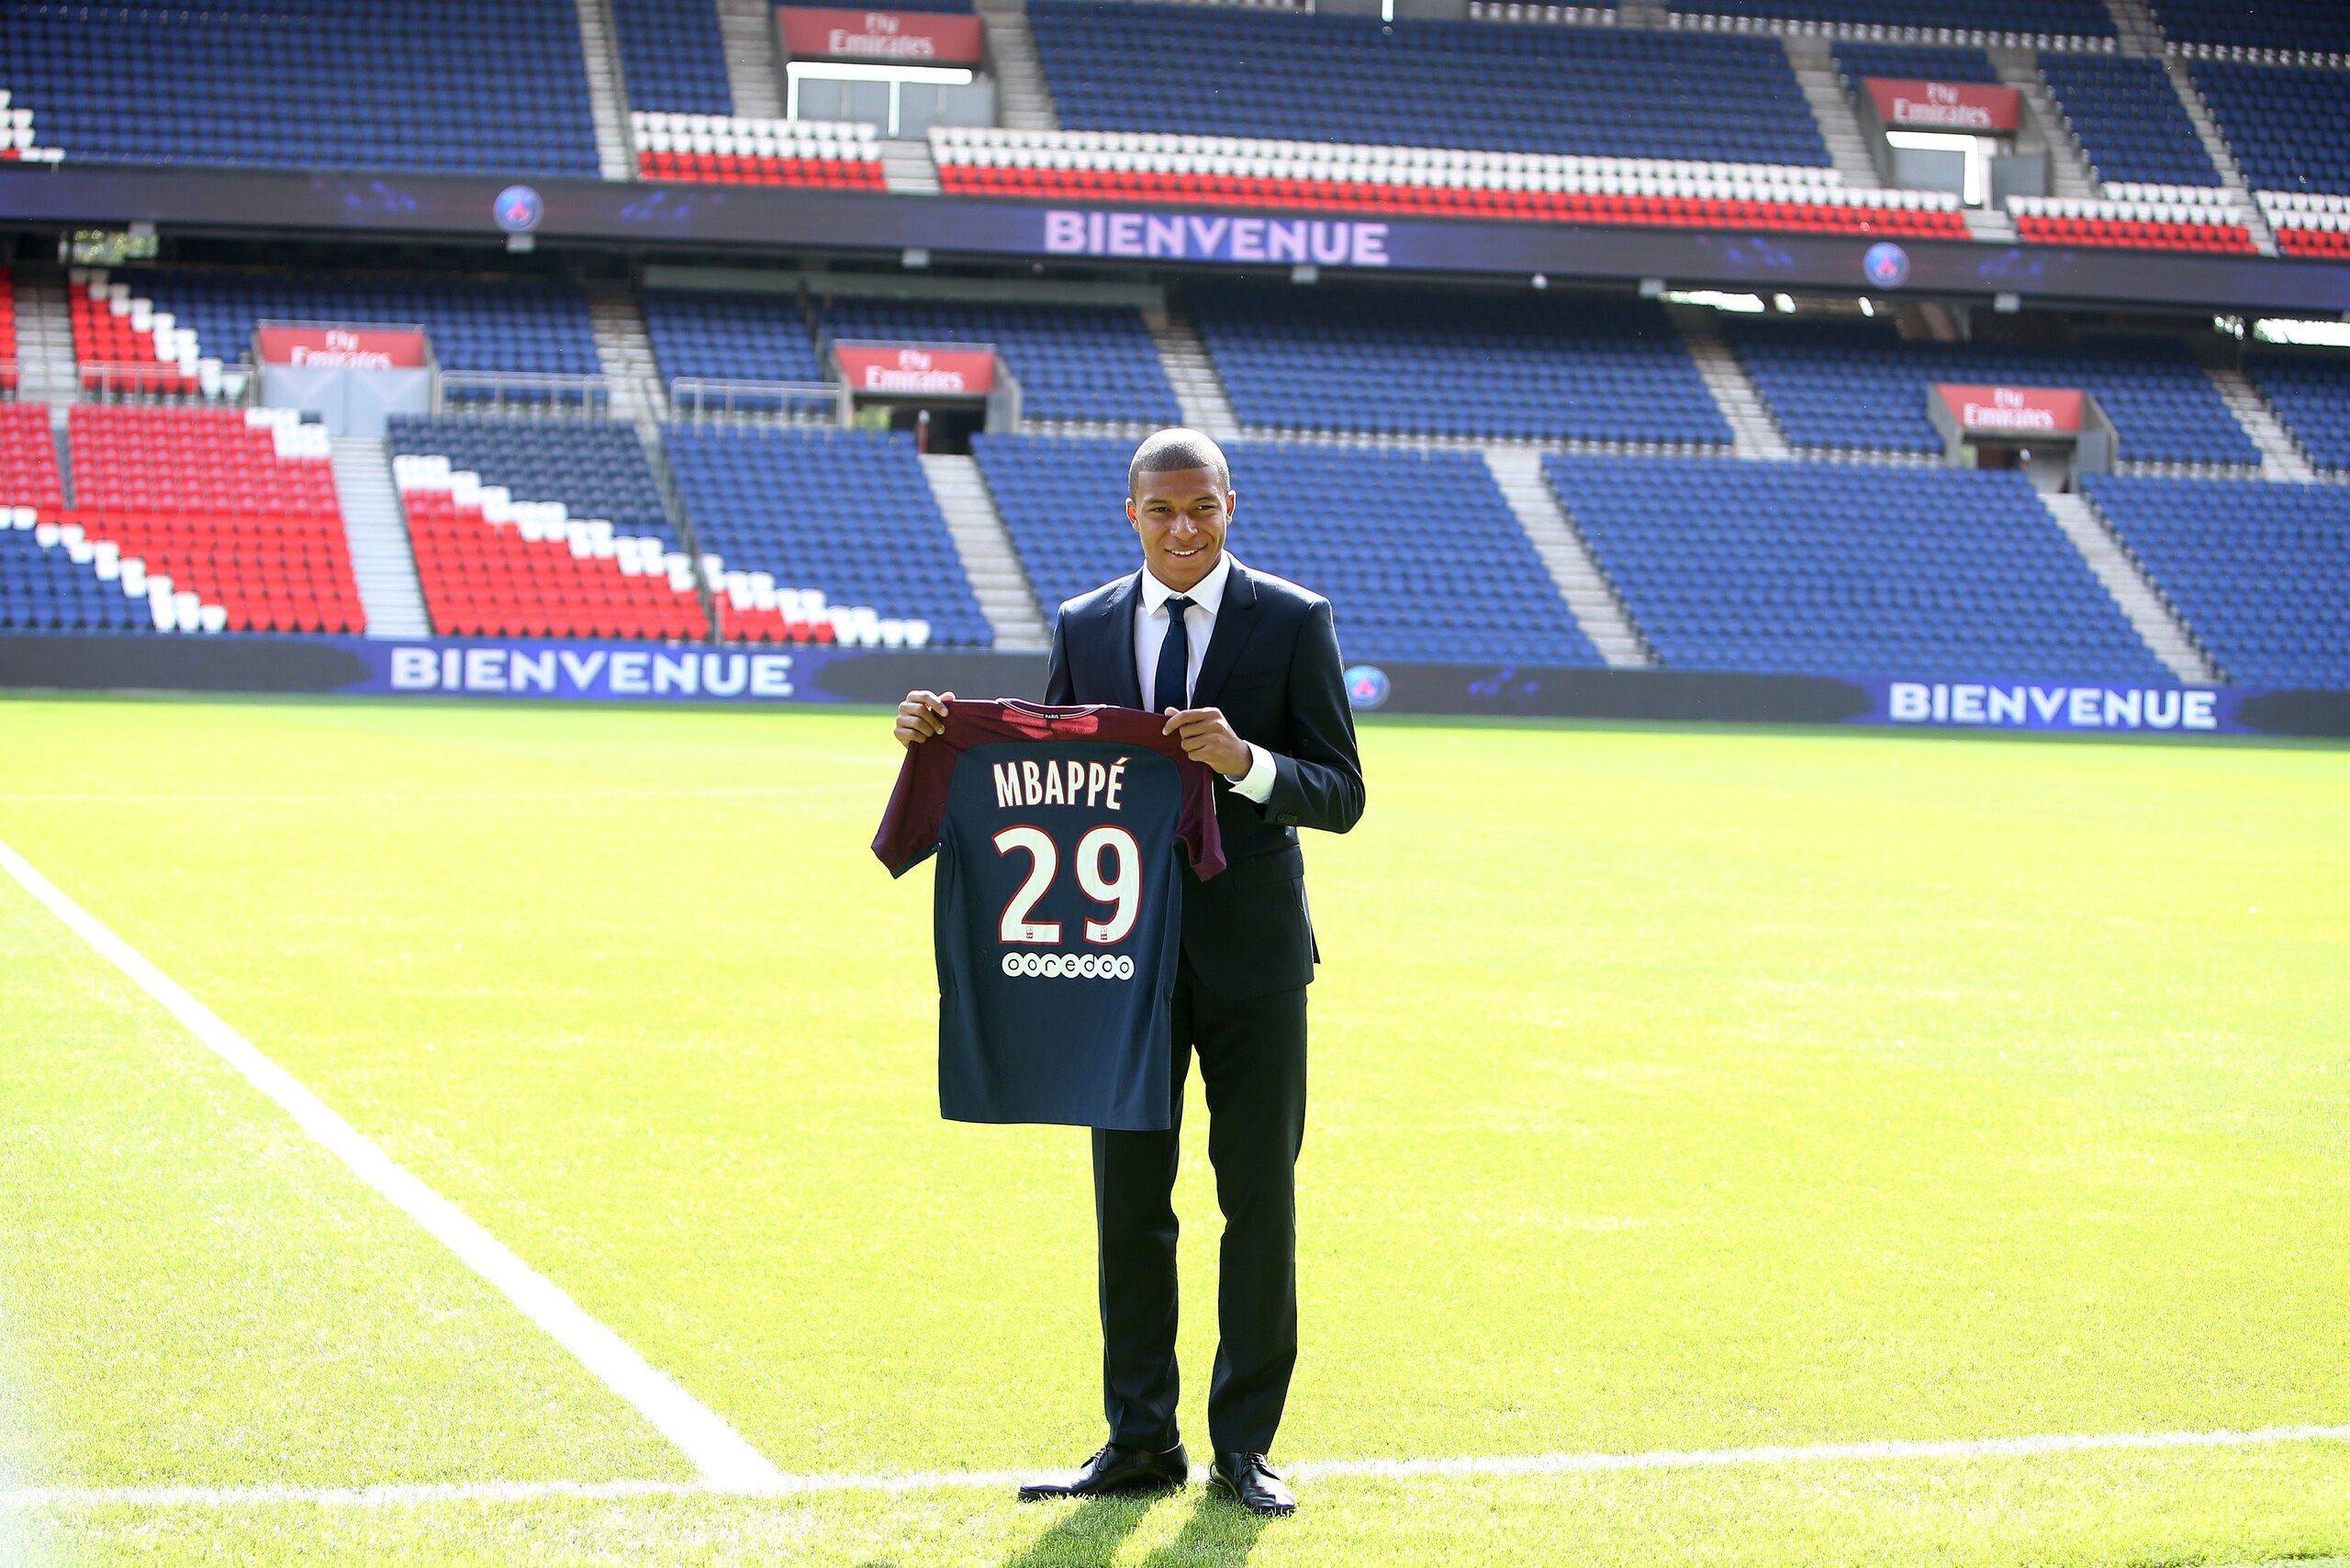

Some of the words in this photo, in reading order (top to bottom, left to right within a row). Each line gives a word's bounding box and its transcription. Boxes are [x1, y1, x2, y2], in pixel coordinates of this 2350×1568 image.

[866, 12, 899, 34] Fly
[829, 29, 934, 59] Emirates
[1927, 83, 1959, 104] Fly
[1893, 98, 1991, 129] Emirates
[1045, 210, 1389, 265] BIENVENUE
[899, 349, 932, 370] Fly
[865, 365, 964, 392] Emirates
[1963, 403, 2054, 430] Emirates
[390, 647, 794, 697] BIENVENUE
[1889, 682, 2217, 729] BIENVENUE
[992, 756, 1131, 810] MBAPPÉ
[991, 824, 1143, 945] 29
[1004, 953, 1132, 978] ooredoo
